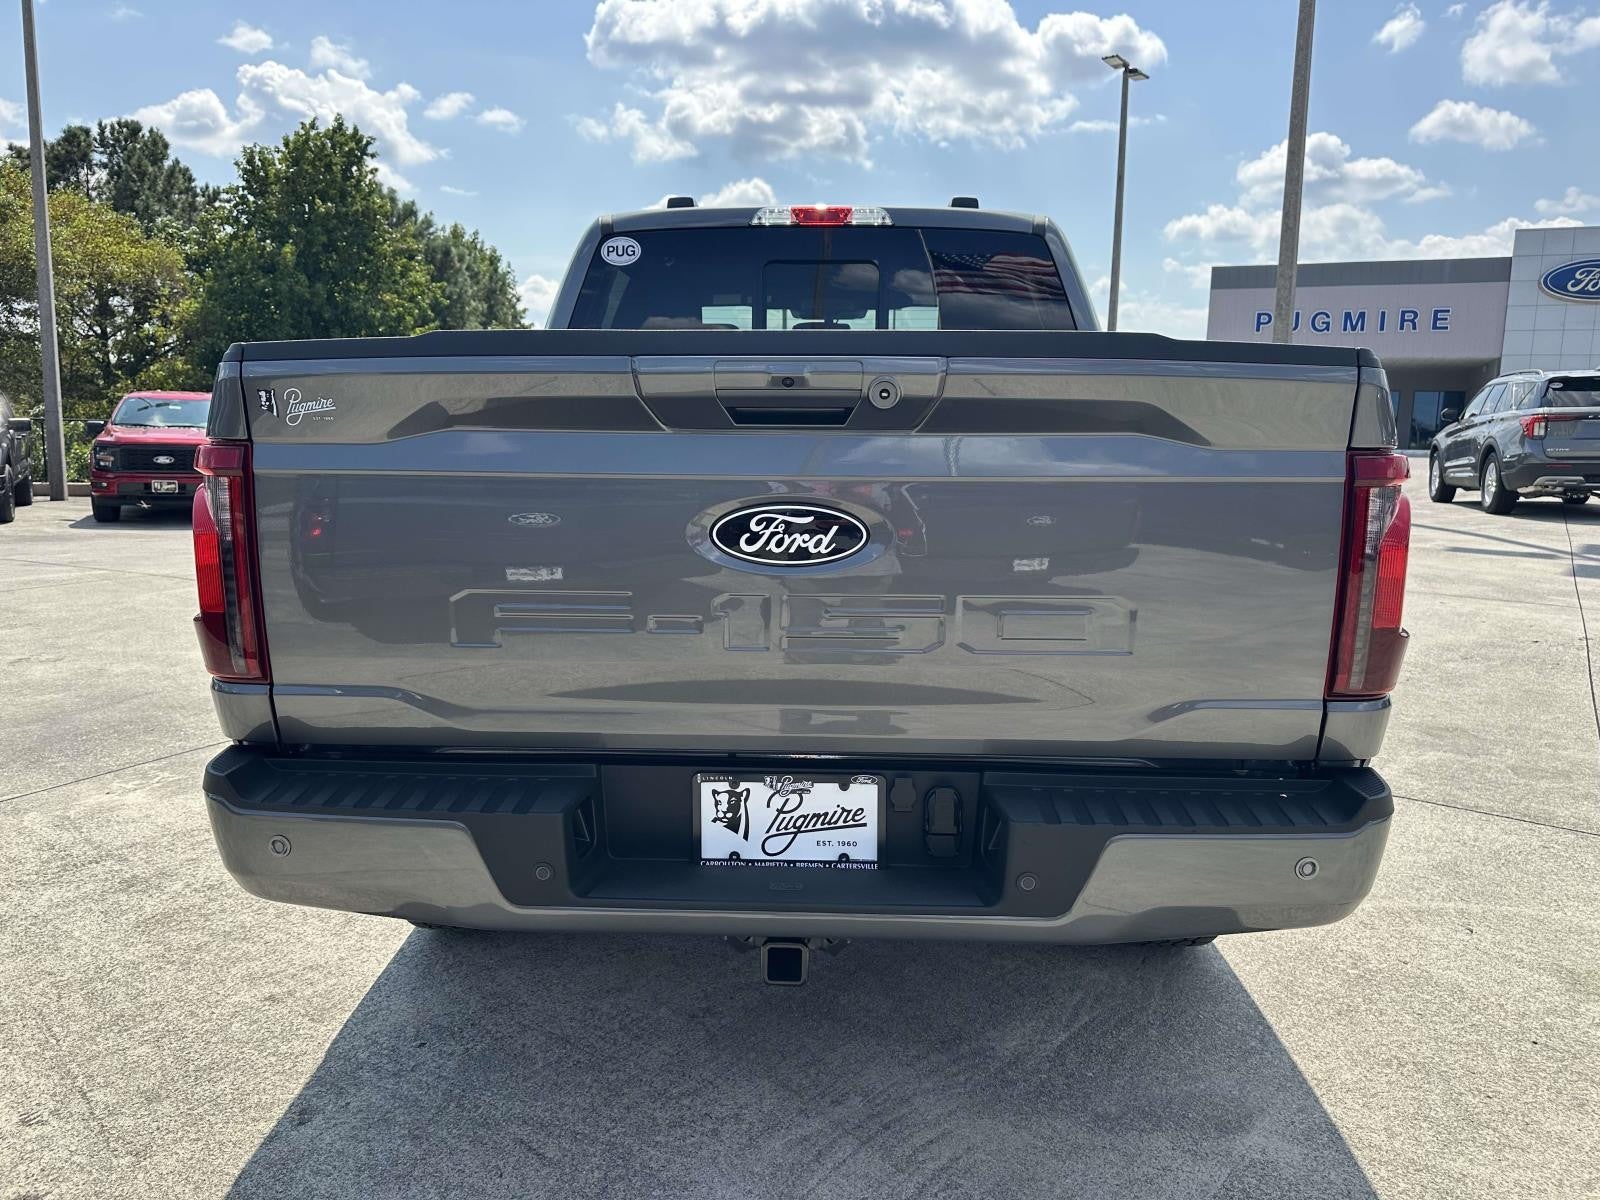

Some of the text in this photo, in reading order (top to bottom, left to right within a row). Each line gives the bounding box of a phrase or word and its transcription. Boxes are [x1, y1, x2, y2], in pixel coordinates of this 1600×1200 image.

[606, 244, 636, 257] PUG
[283, 387, 337, 426] Pugmire
[739, 513, 840, 554] Ford
[450, 588, 1136, 656] F-150
[761, 789, 868, 857] Pugmire
